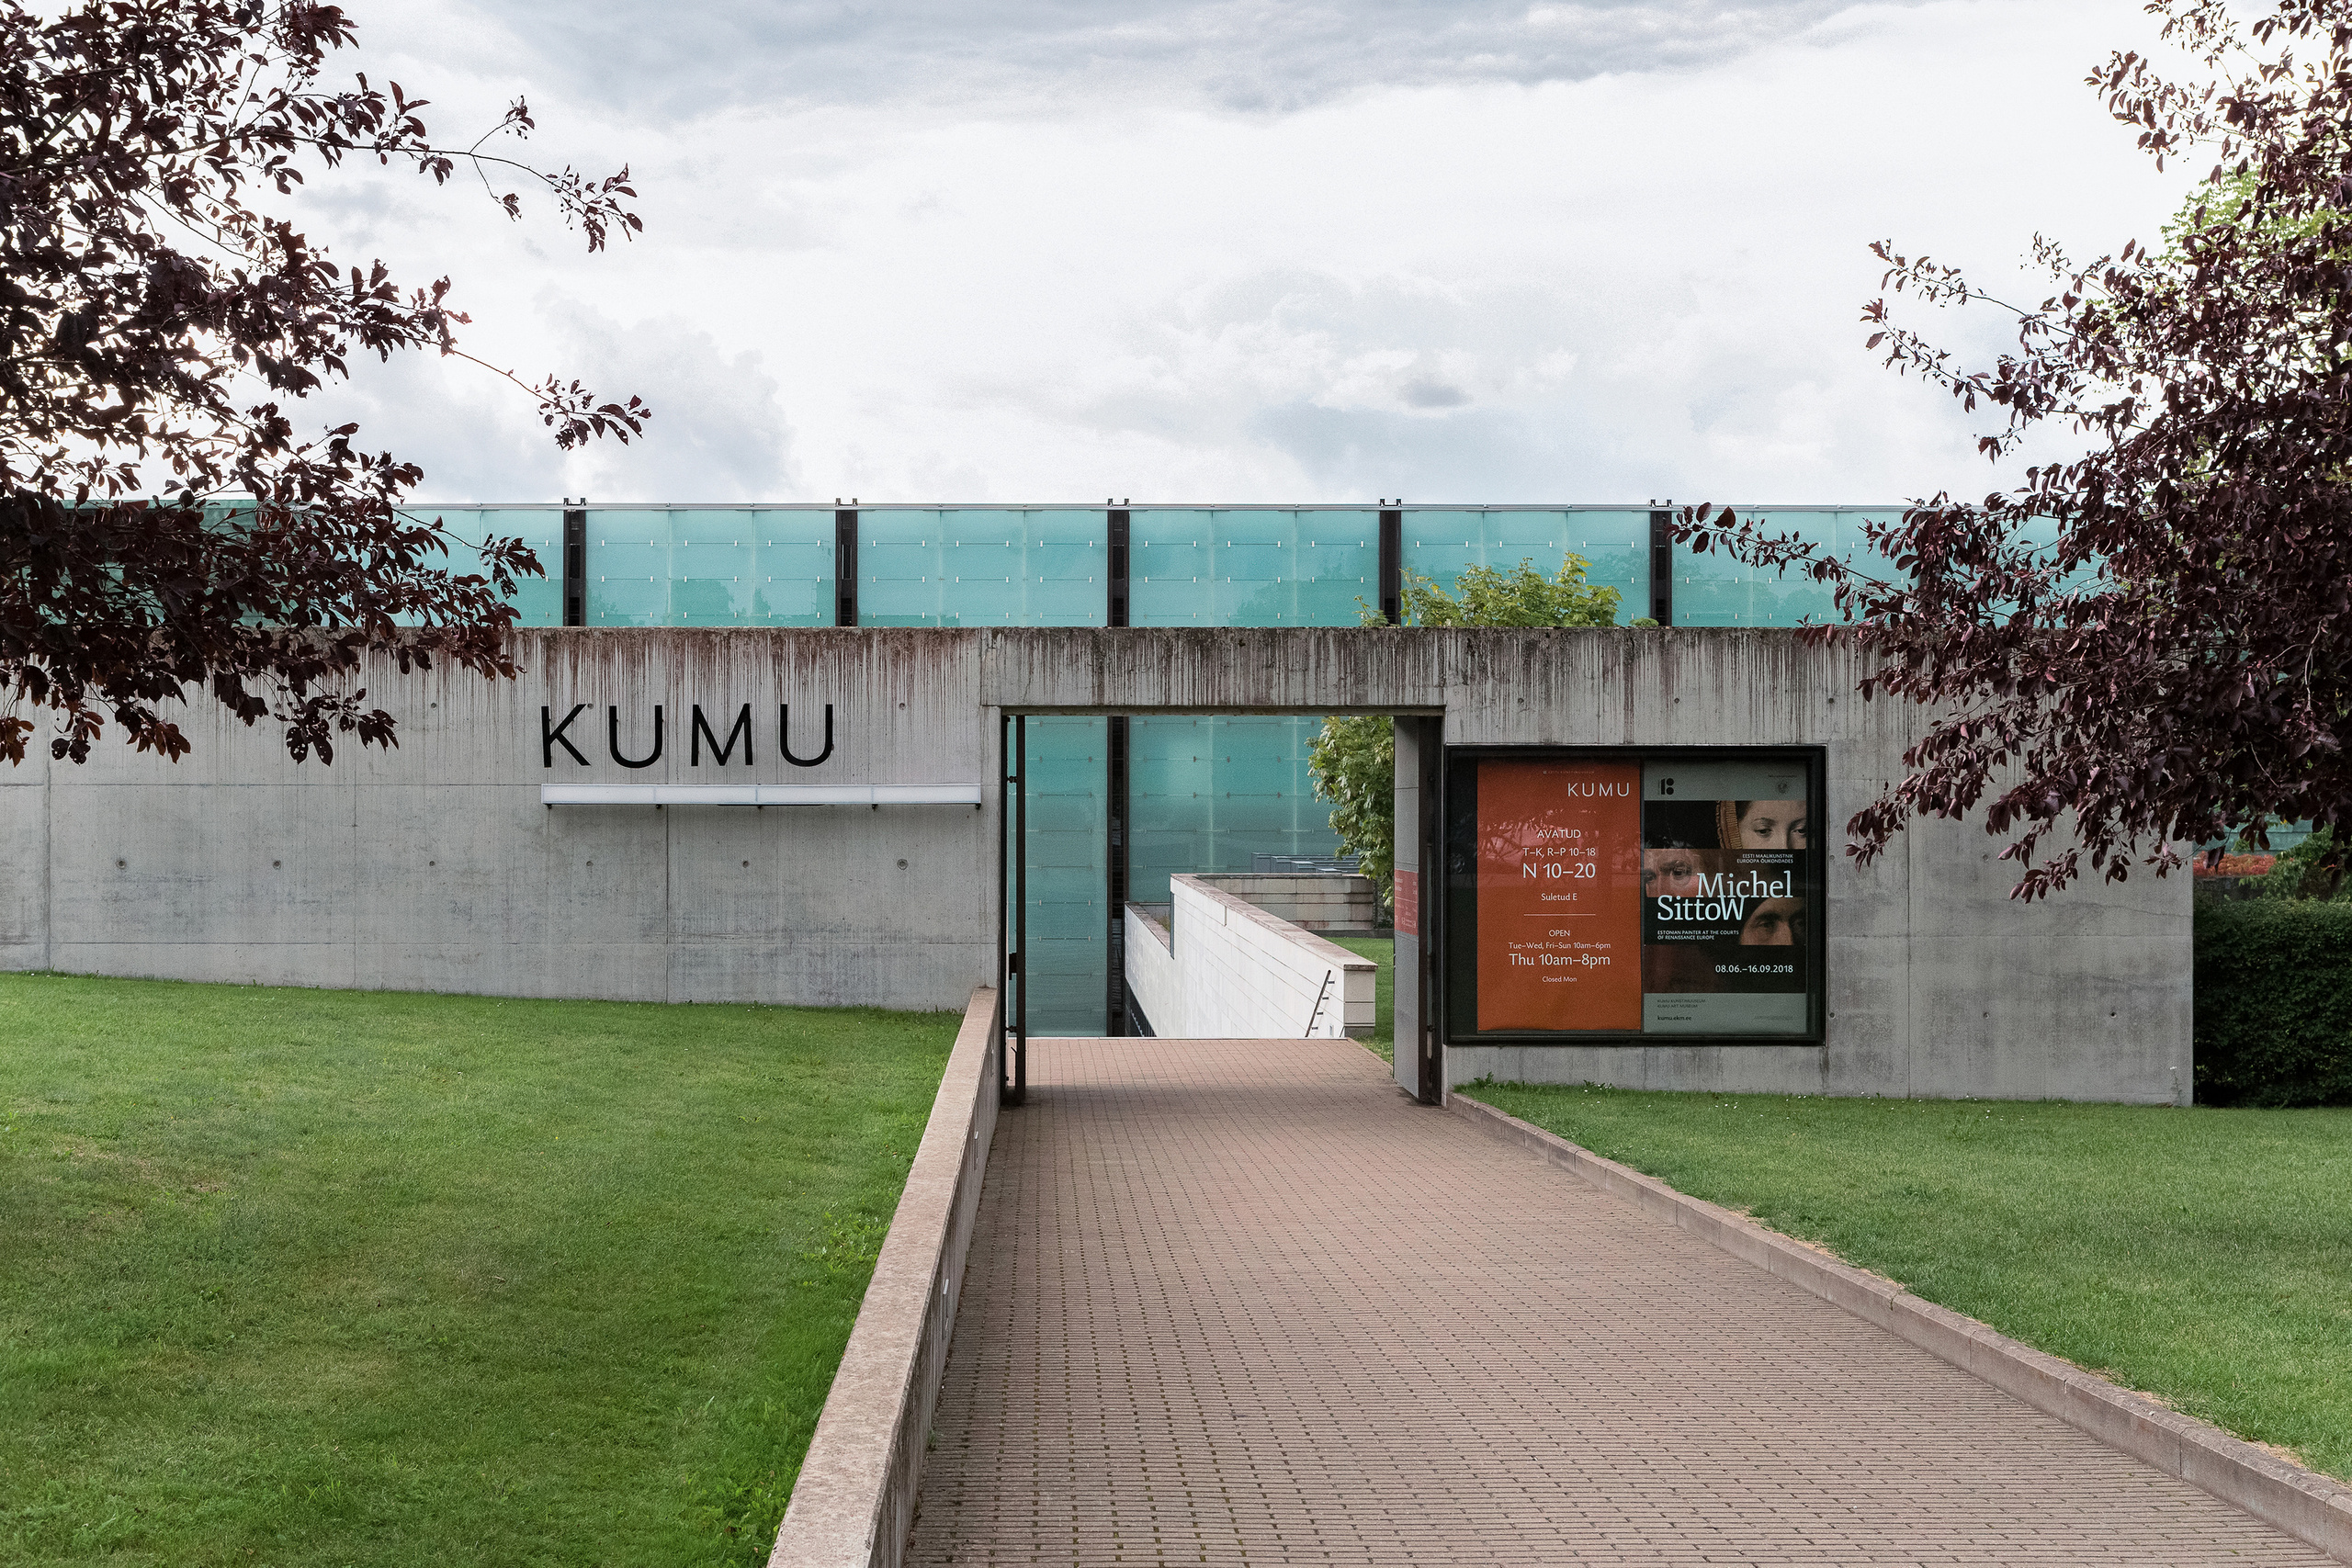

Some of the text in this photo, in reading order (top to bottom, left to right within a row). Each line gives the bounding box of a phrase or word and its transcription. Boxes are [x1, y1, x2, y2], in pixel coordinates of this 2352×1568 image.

[541, 703, 834, 769] KUMU
[1567, 782, 1631, 797] KUMU
[1536, 829, 1581, 839] AVATUD
[1522, 863, 1597, 879] N 10–20
[1696, 870, 1793, 898] Michel
[1541, 892, 1577, 901] Suletud E
[1548, 929, 1570, 937] OPEN
[1509, 953, 1535, 965] Thu
